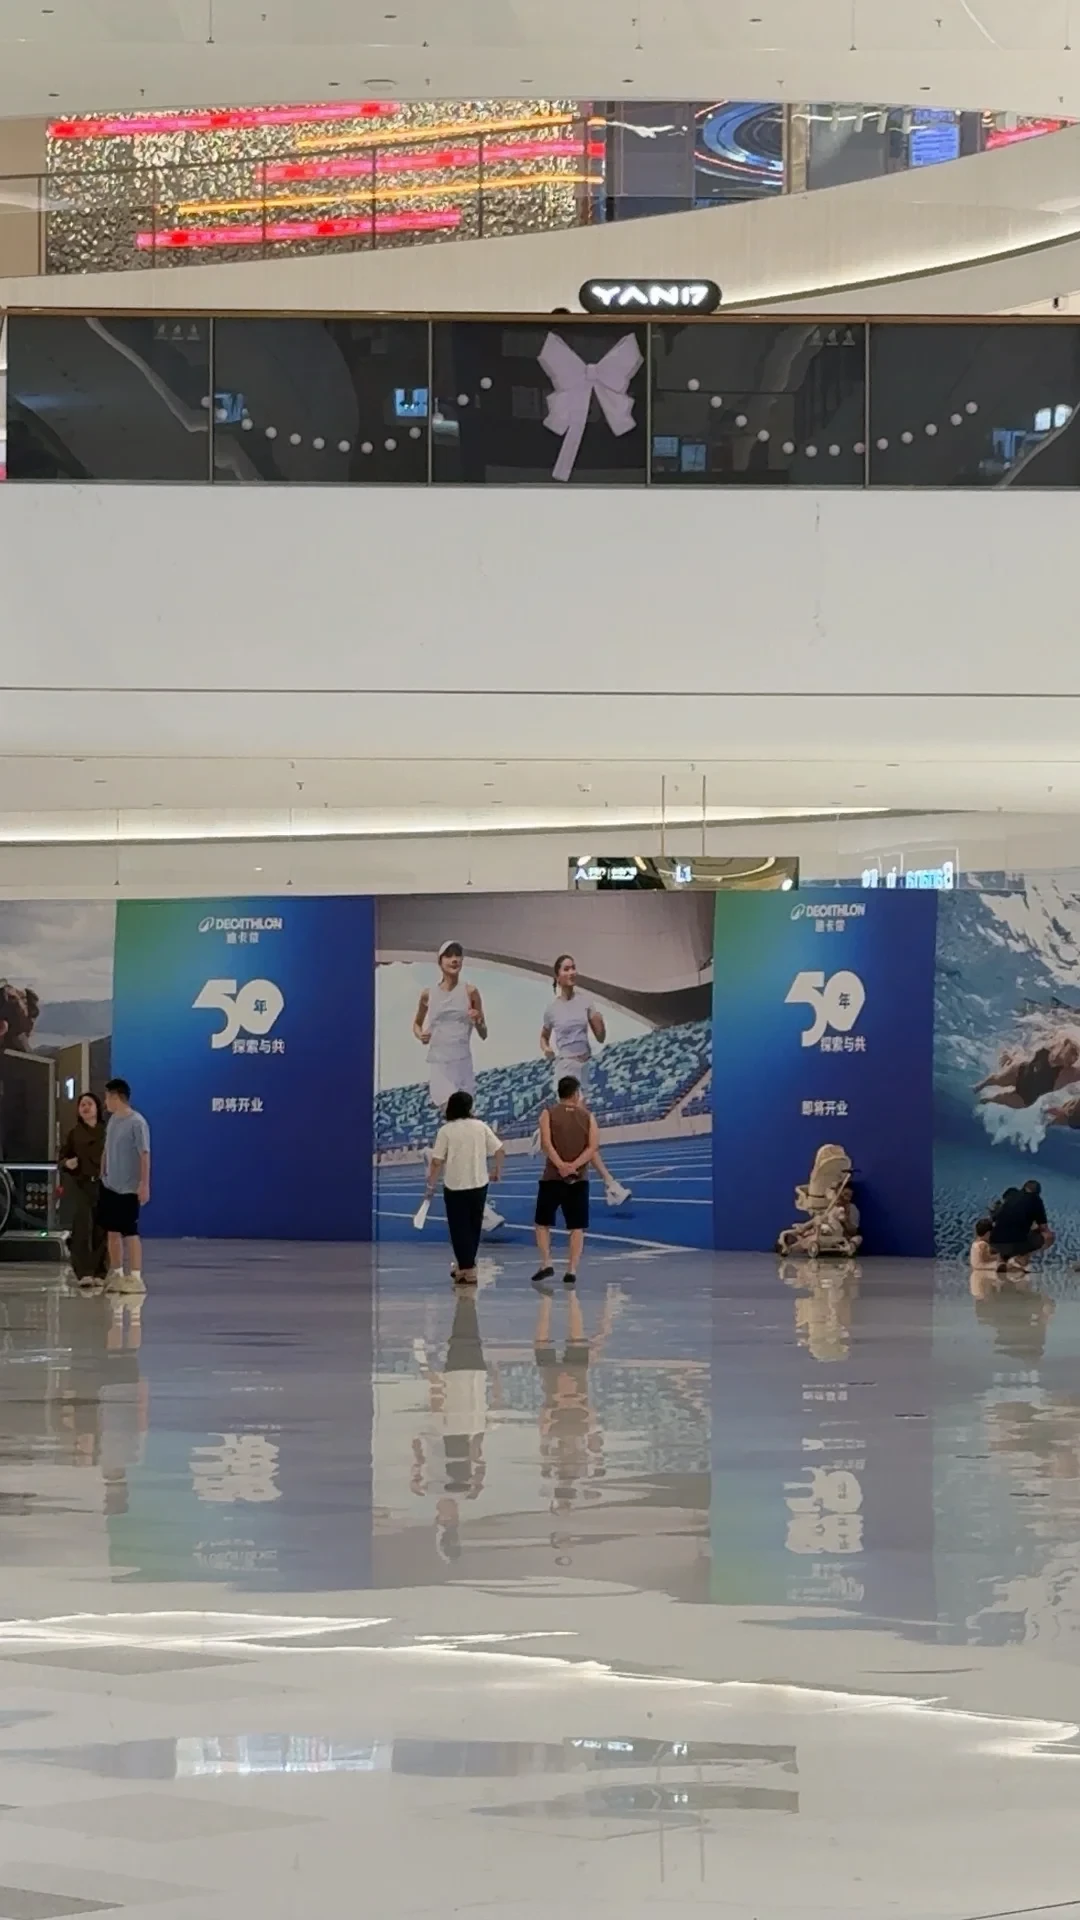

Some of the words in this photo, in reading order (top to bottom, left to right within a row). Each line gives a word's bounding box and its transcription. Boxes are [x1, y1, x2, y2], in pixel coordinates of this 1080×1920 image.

[806, 903, 866, 917] DECATHLON
[215, 918, 283, 930] DECATHLON
[232, 1039, 285, 1054] 探索与共
[820, 1036, 866, 1052] 探索与共
[212, 1097, 264, 1112] 即将开业
[801, 1100, 848, 1116] 即将开业
